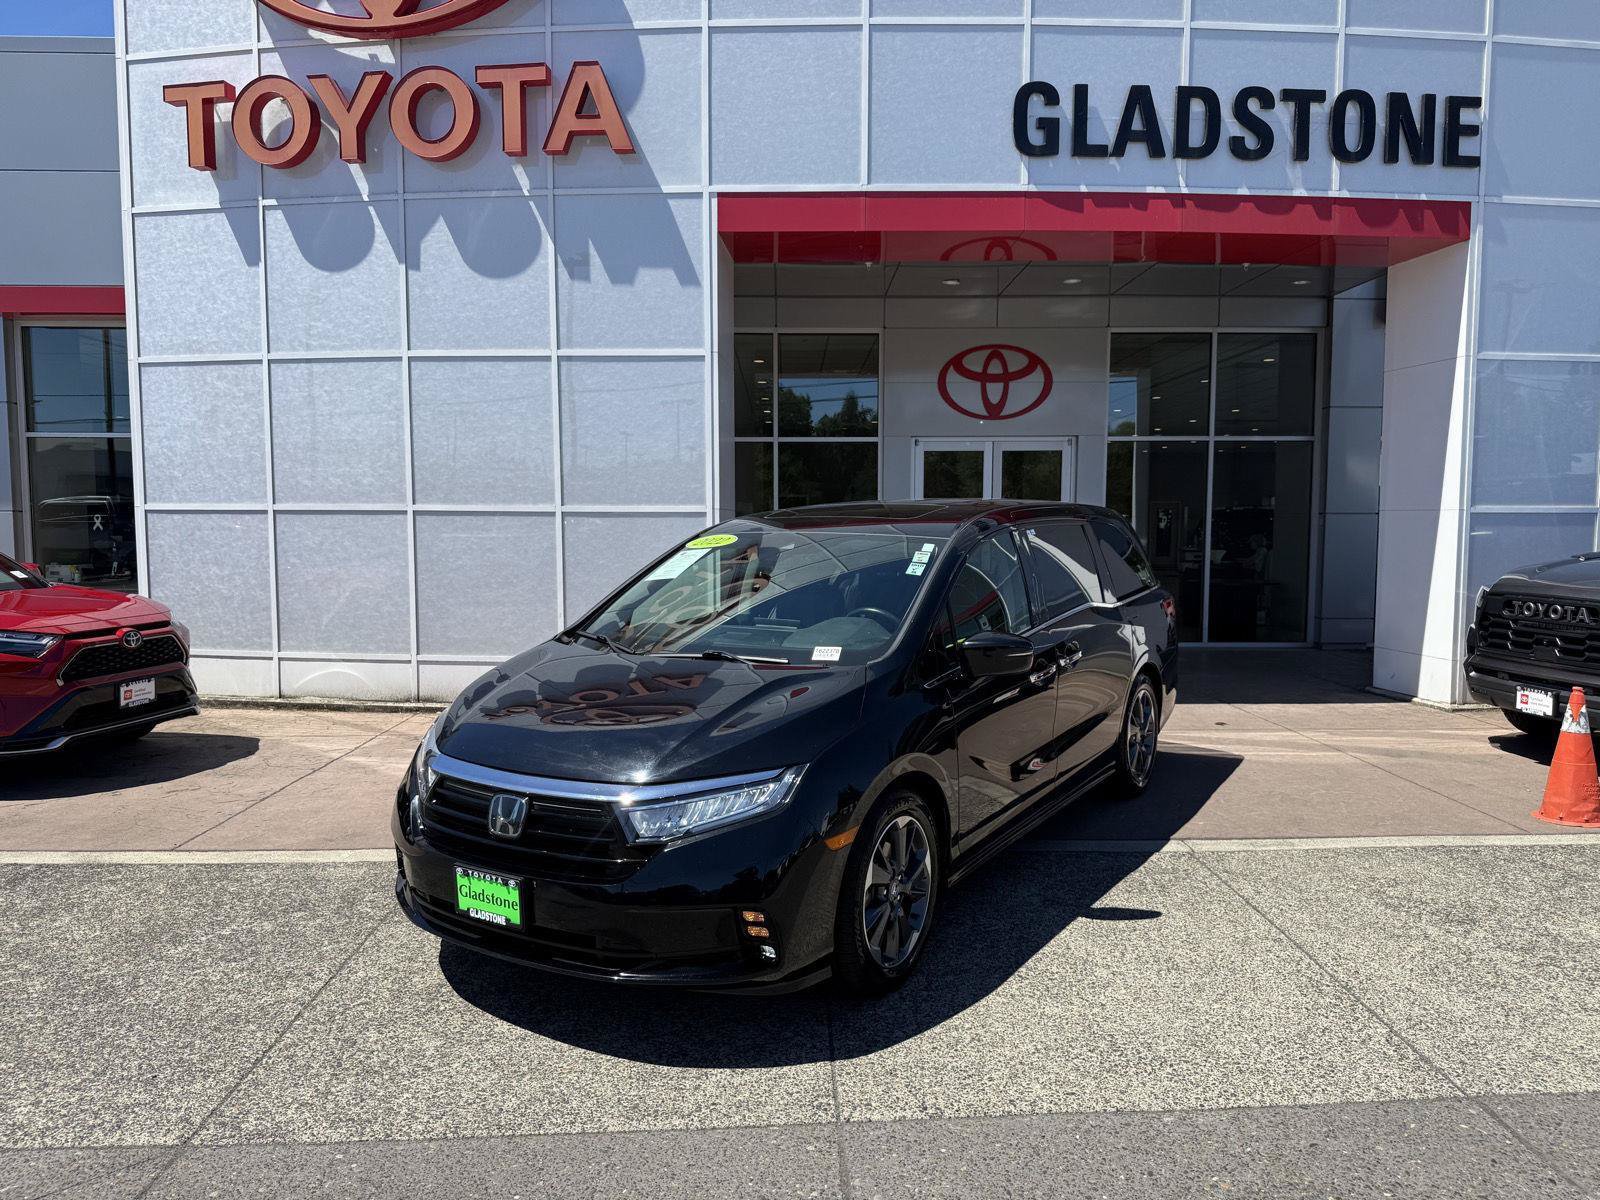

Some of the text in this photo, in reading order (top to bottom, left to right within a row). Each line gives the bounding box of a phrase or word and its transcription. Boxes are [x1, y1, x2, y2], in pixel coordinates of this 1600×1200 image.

[163, 60, 636, 171] TOYOTA
[1013, 80, 1482, 168] GLADSTONE
[1512, 600, 1590, 623] TOYOTA
[468, 870, 503, 884] TOYOTA
[459, 884, 519, 911] Gladstone
[469, 908, 506, 925] GLADSTONE
